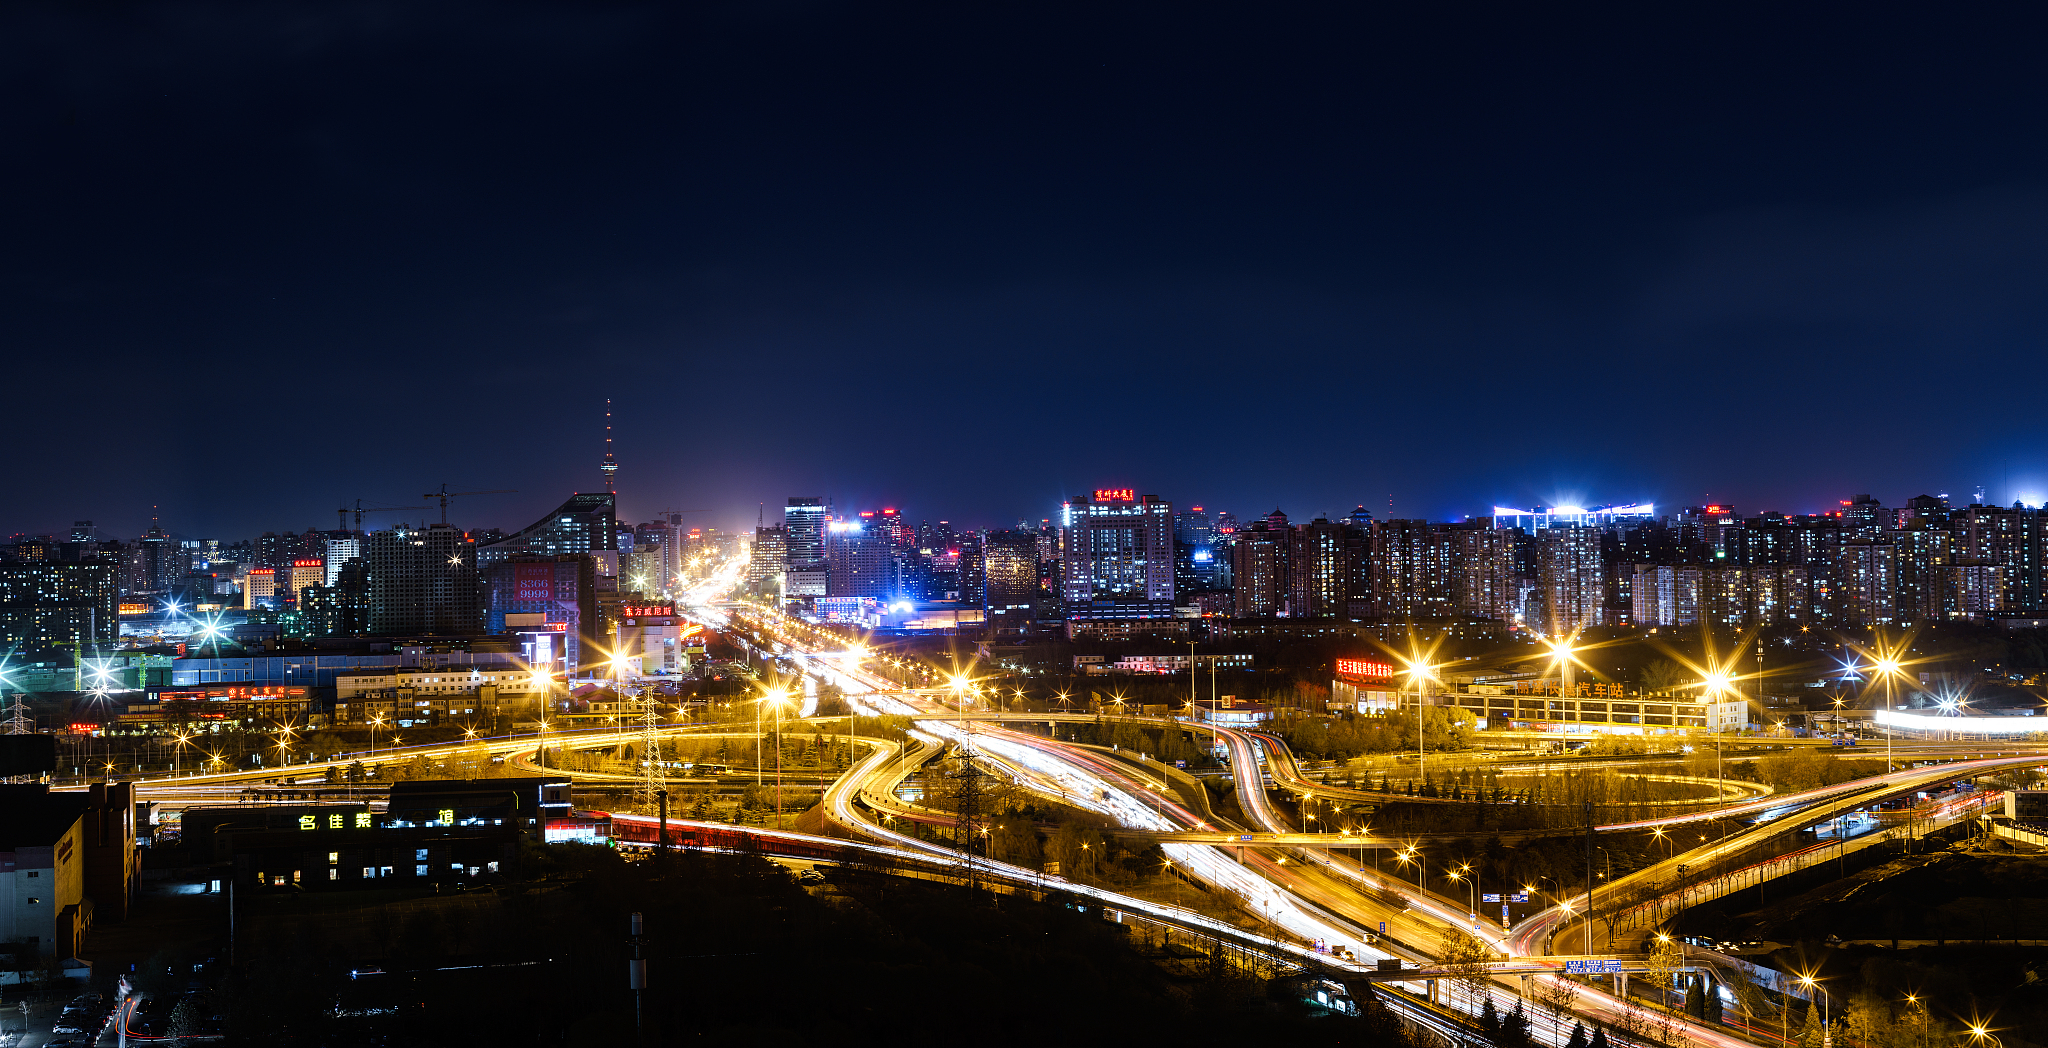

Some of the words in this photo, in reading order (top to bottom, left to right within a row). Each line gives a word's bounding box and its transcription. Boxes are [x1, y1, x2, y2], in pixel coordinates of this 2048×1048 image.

[520, 579, 548, 588] 8366
[520, 589, 549, 599] 9999
[625, 606, 672, 617] 东方威尼斯
[1516, 679, 1624, 698] 丽泽长途汽车站
